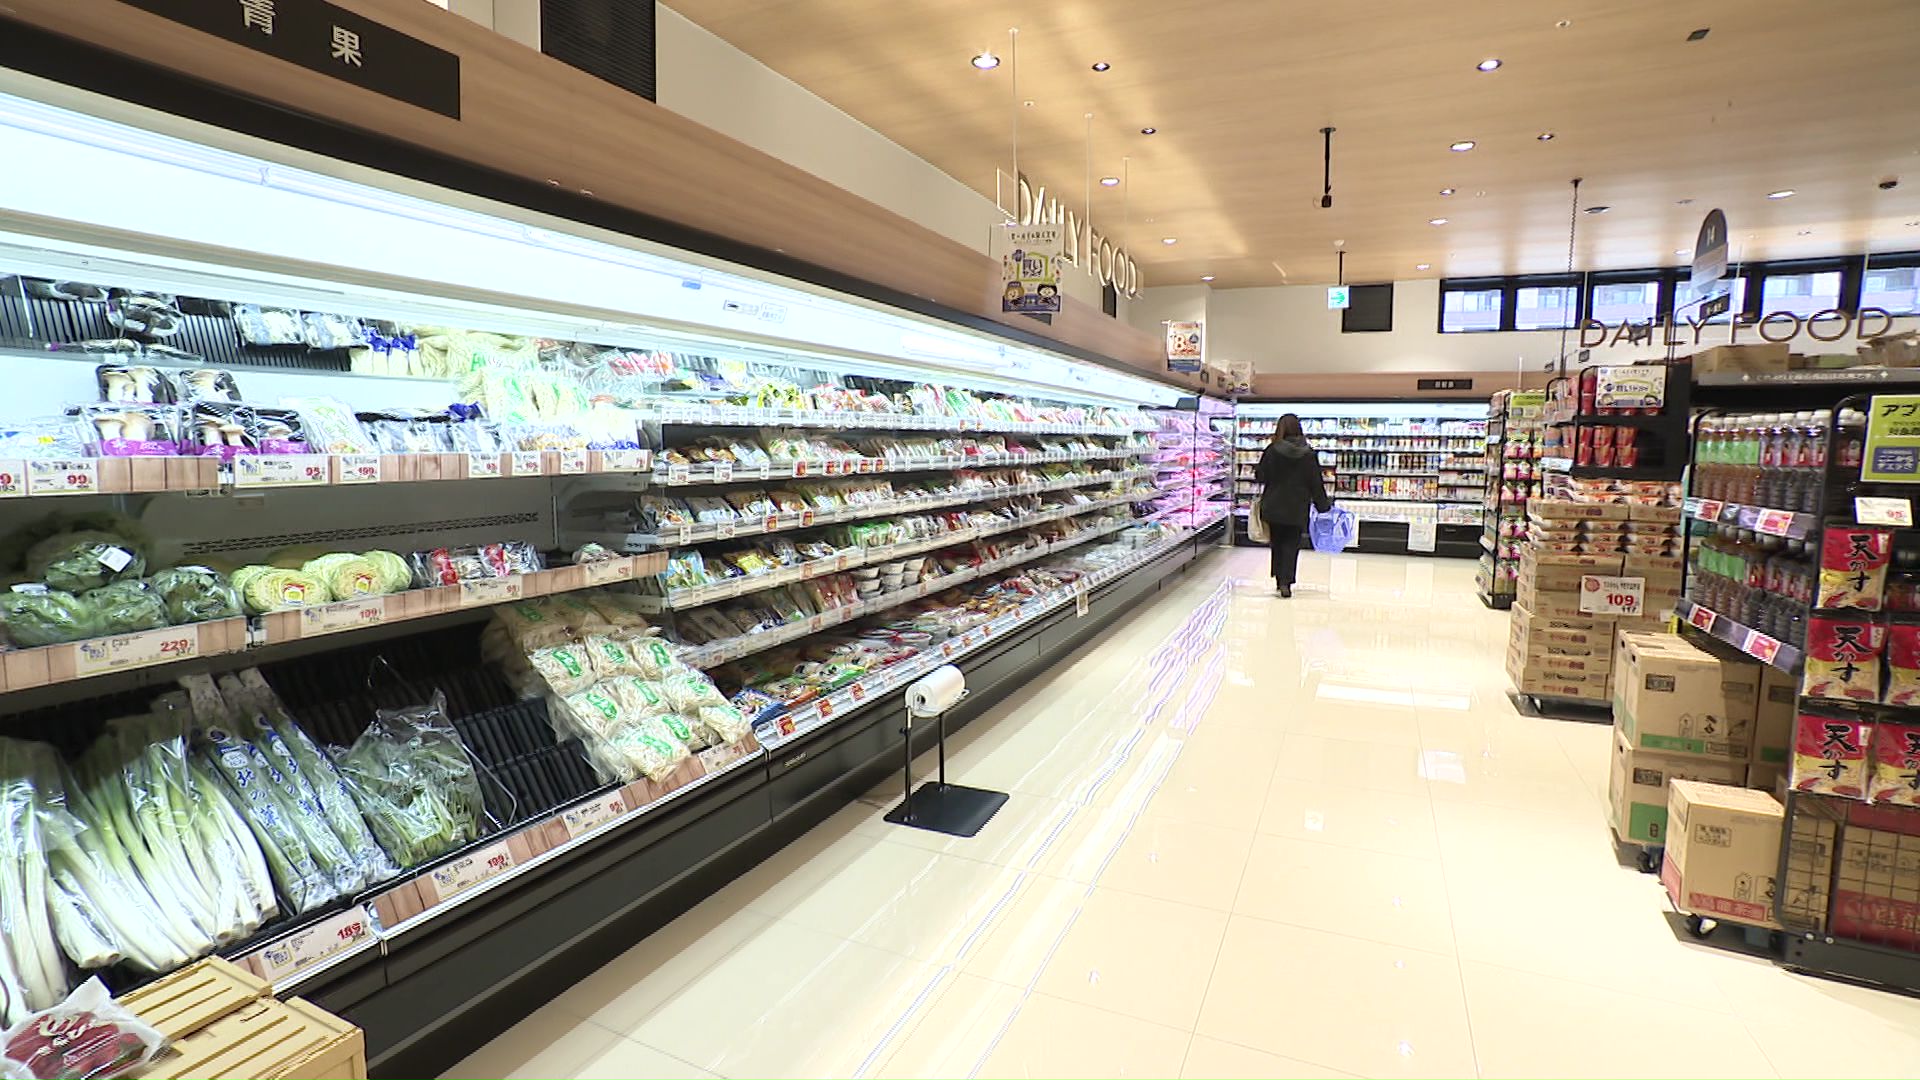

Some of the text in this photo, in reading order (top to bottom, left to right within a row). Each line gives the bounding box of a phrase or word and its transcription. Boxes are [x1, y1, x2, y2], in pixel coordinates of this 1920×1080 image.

[1016, 168, 1140, 300] DAILY FOOD
[1579, 306, 1894, 349] DAILY FOOD
[1847, 534, 1878, 592] 天かす
[1606, 593, 1634, 607] 109
[161, 640, 188, 652] 229
[1831, 626, 1872, 682] 天かす
[1819, 723, 1857, 780] 天かす
